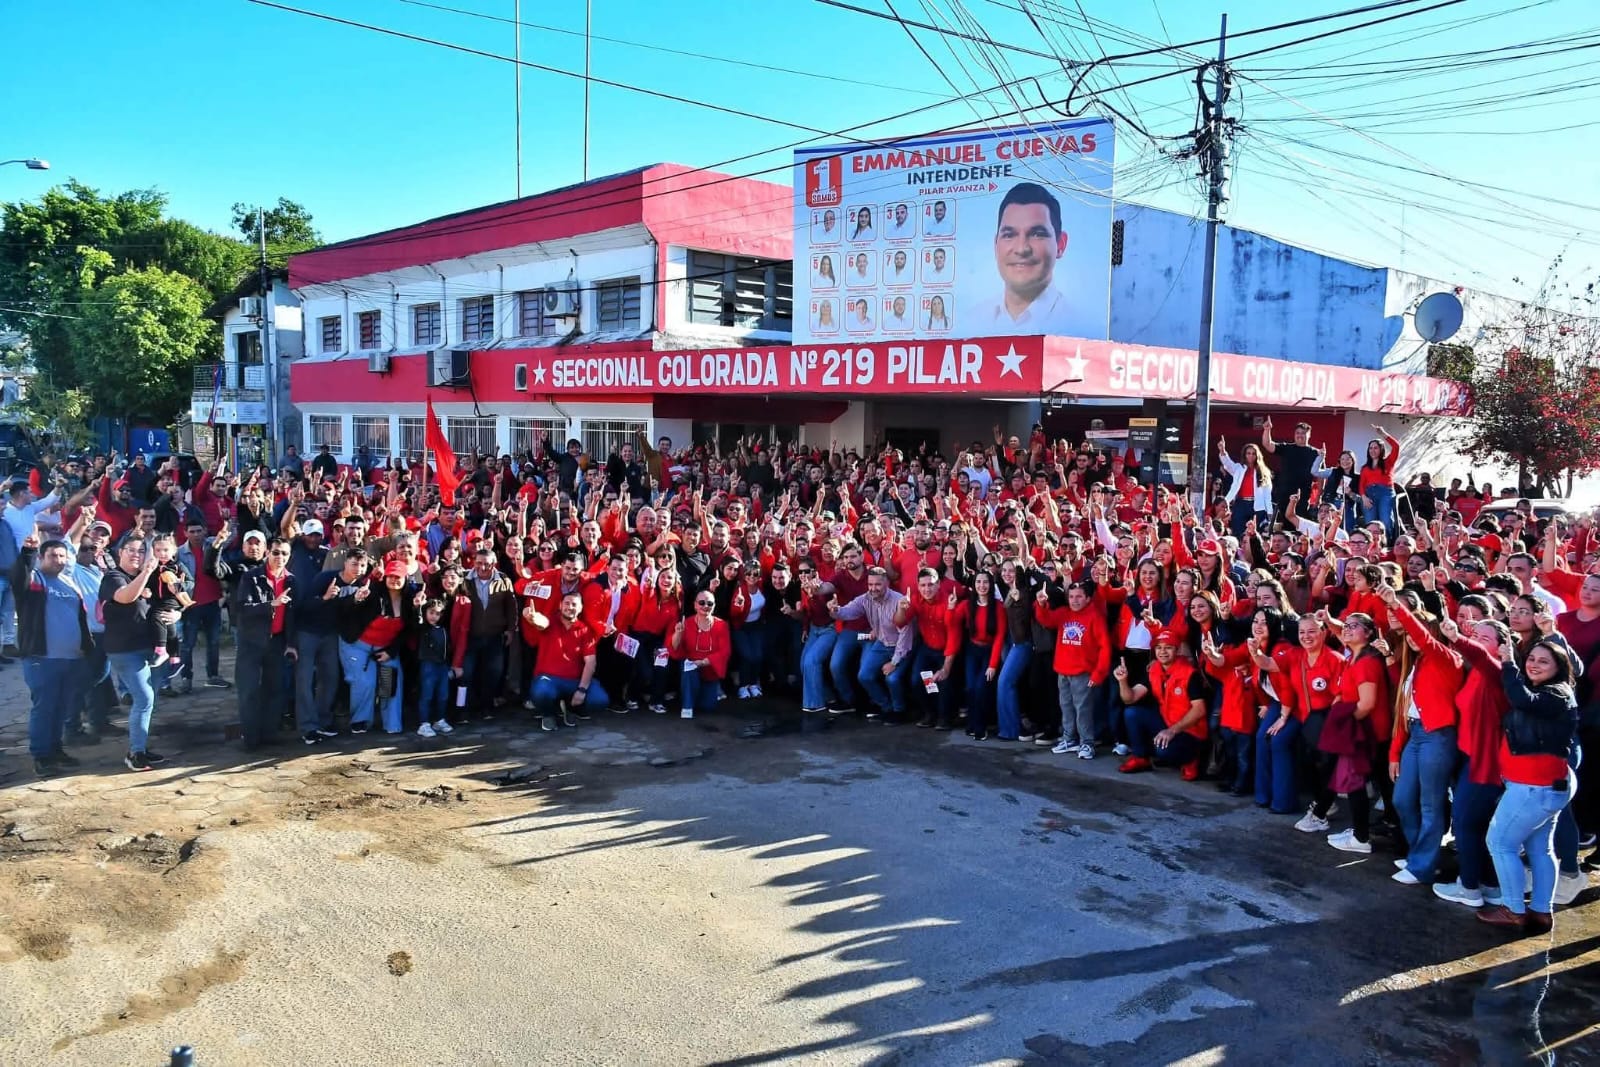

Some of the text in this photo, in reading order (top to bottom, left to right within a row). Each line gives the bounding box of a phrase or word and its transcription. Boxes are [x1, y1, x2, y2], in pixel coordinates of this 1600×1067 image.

[853, 133, 1096, 173] EMMANUEL CUEVAS
[907, 164, 1012, 184] INTENDENTE
[919, 183, 985, 196] PILAR AVANZA
[812, 194, 836, 203] SOMOS
[847, 302, 855, 312] 10
[885, 300, 892, 311] 11
[922, 299, 931, 310] 12
[552, 344, 983, 388] SECCIONAL COLORADA Nº 219 PILAR
[1109, 349, 1235, 395] SECCIOAL
[1243, 362, 1336, 403] COLORADA
[1381, 377, 1407, 407] 219
[1413, 380, 1450, 411] PILAR
